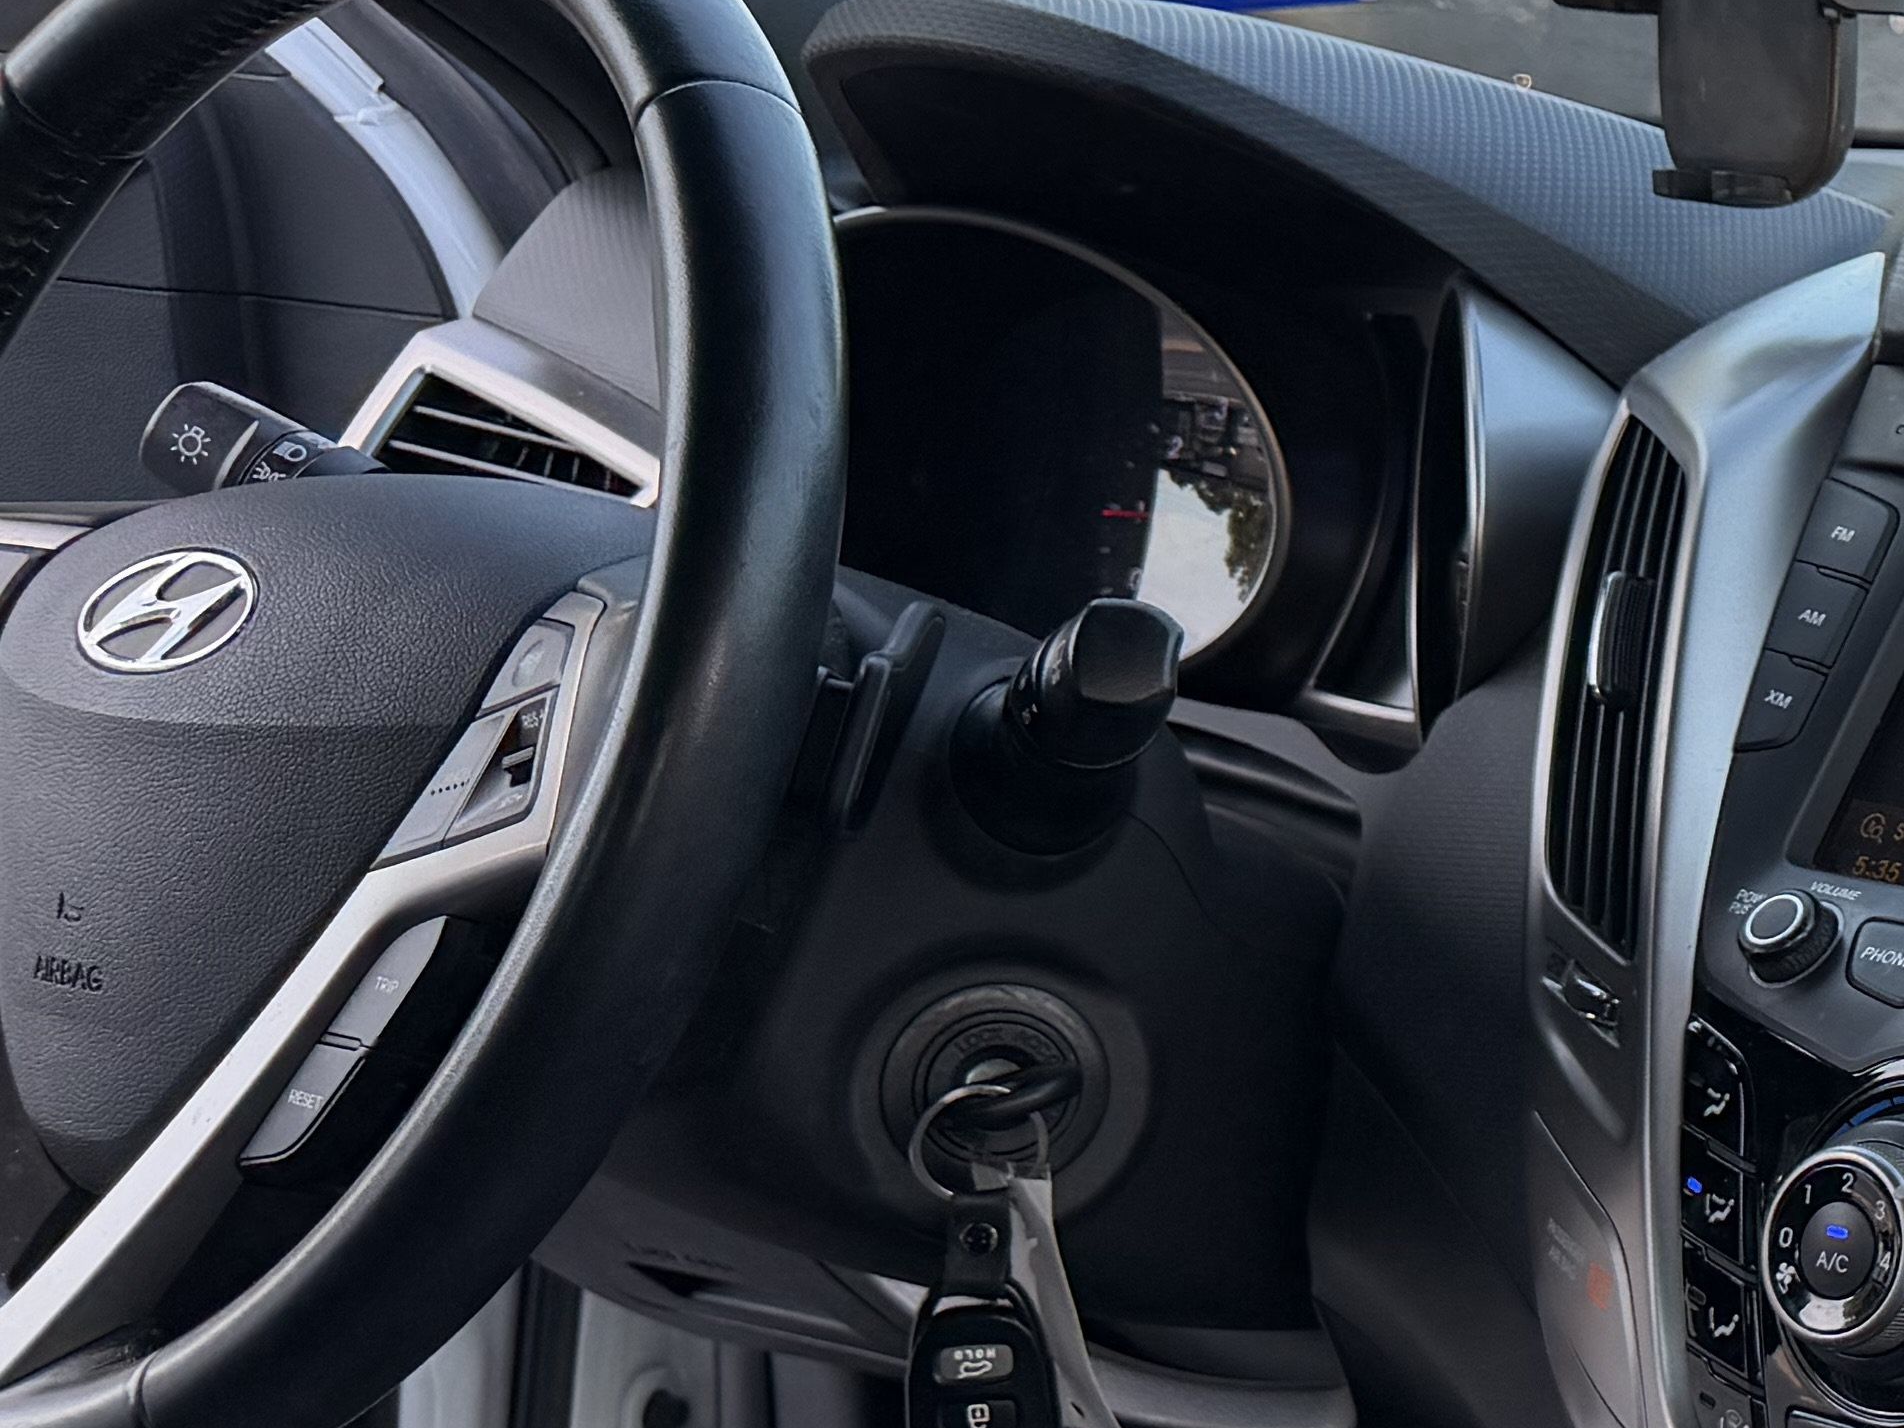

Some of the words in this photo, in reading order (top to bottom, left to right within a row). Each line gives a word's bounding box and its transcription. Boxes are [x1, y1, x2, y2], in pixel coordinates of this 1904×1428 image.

[1830, 525, 1856, 544] FM
[1798, 609, 1826, 627] AM
[1764, 689, 1793, 709] XM
[1852, 855, 1903, 883] 5:35
[1811, 881, 1862, 901] VOLUME
[33, 955, 103, 992] AIRBAG
[375, 975, 399, 994] TRIP
[287, 1088, 324, 1111] RESET
[1841, 1172, 1855, 1193] 2
[1804, 1183, 1813, 1205] 1
[1874, 1200, 1886, 1221] 3
[1778, 1227, 1794, 1248] 0
[1815, 1250, 1849, 1273] A/C
[1879, 1251, 1891, 1272] 4
[954, 1347, 996, 1361] HOLD
